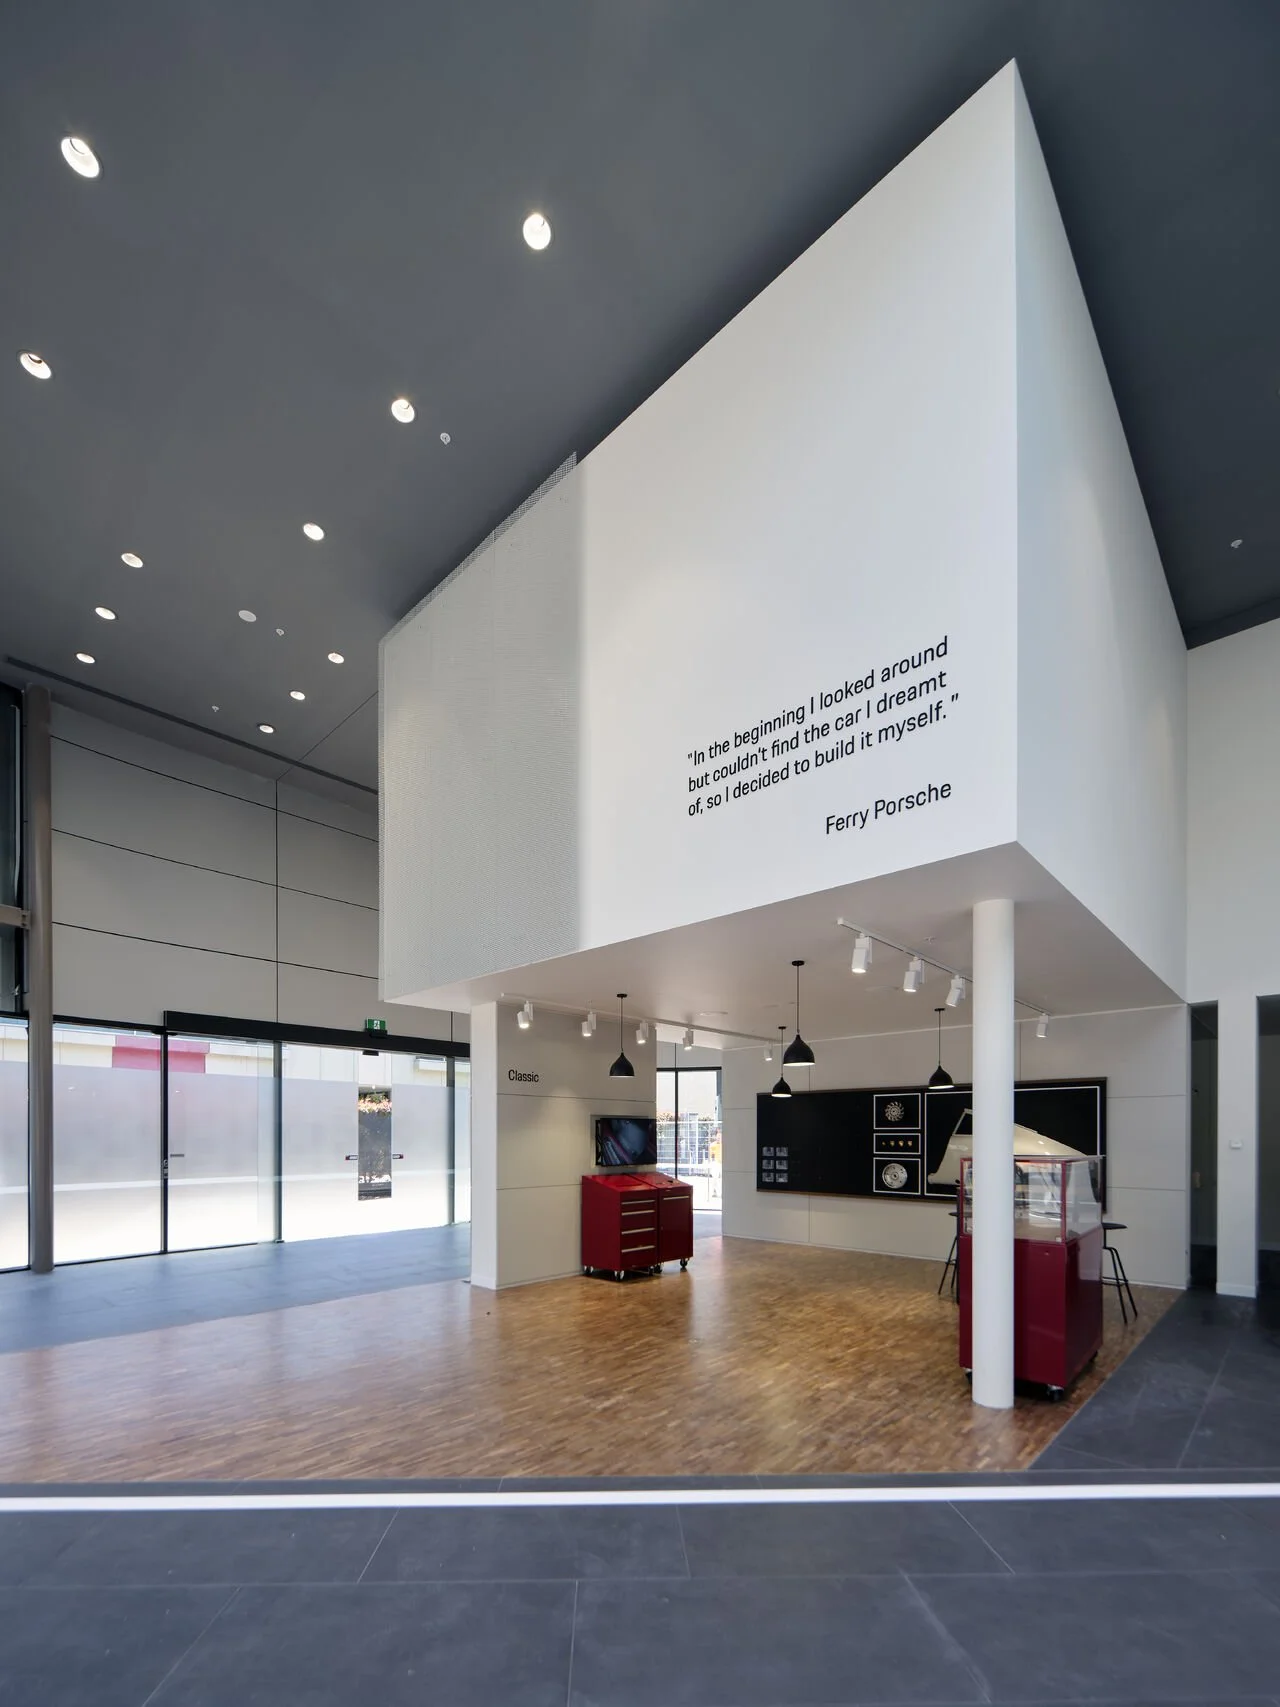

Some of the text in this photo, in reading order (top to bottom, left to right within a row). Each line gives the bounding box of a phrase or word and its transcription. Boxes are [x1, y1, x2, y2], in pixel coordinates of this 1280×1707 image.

[688, 635, 948, 766] "In the beginning I looked around
[689, 671, 947, 792] but couldn't find the car I dreamt
[688, 797, 704, 816] of,
[707, 794, 722, 809] so
[725, 786, 730, 802] I
[733, 762, 790, 799] decided
[794, 759, 811, 775] to
[815, 735, 855, 768] build
[860, 731, 874, 750] it
[826, 783, 951, 835] Ferry Porsche
[508, 1069, 539, 1083] Classic
